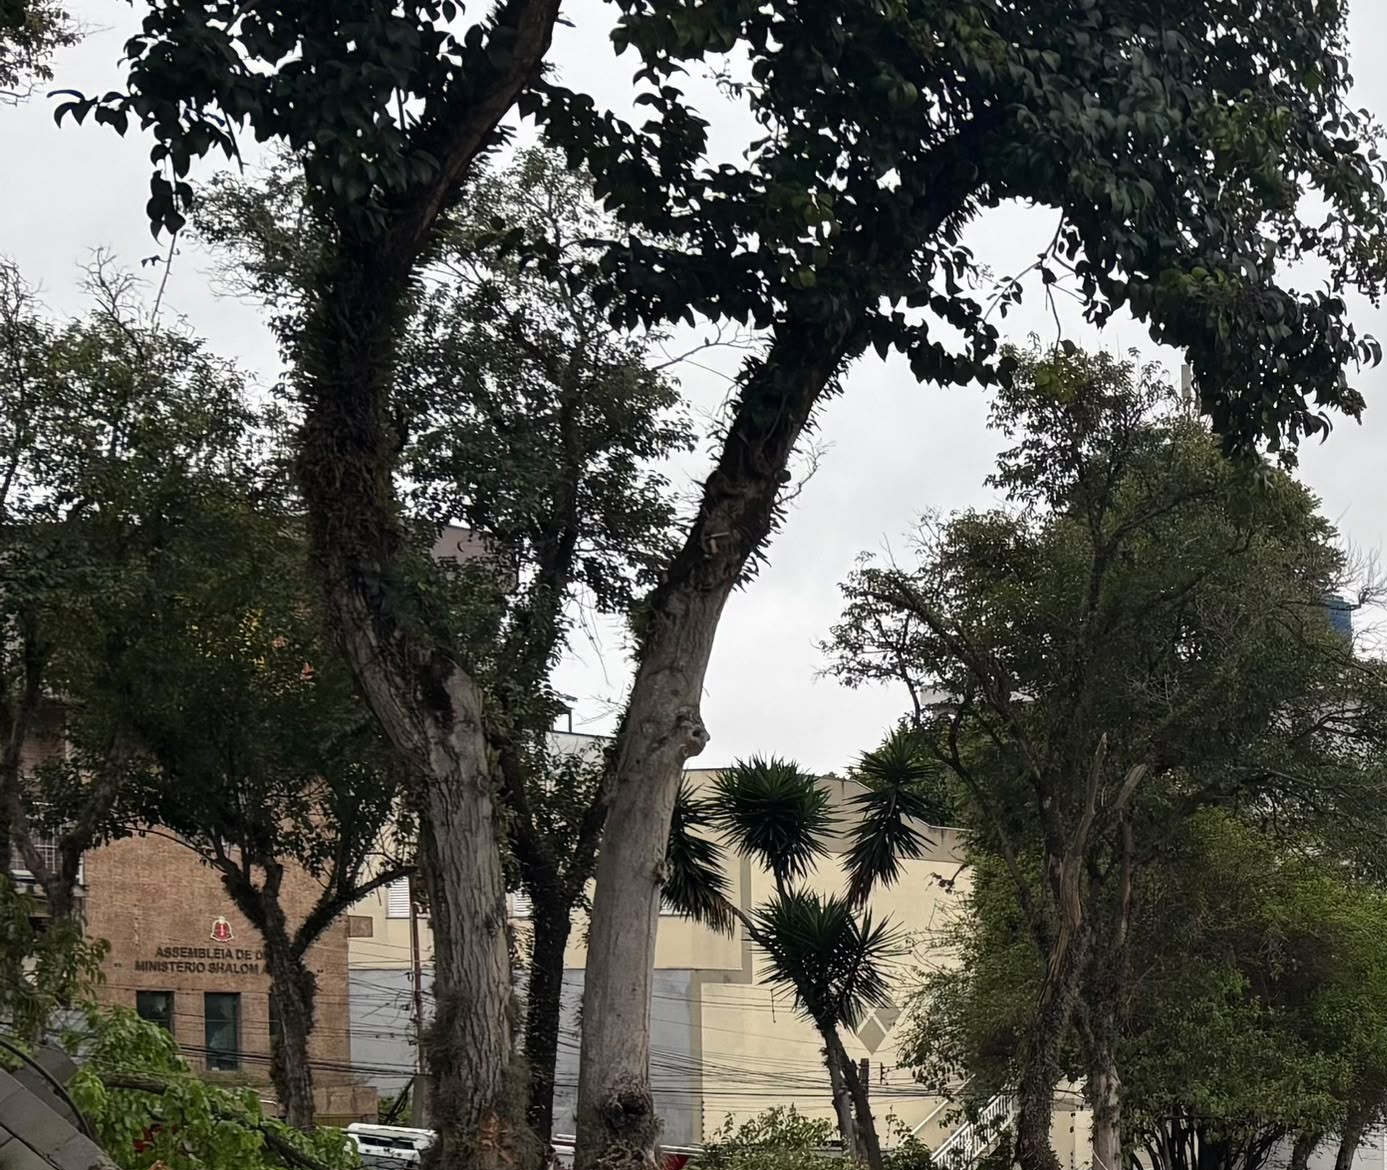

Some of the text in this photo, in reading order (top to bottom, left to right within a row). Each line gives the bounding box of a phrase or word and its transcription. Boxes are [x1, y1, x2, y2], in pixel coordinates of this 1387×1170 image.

[155, 947, 233, 960] ASSEMBLEIA
[236, 948, 252, 960] DE
[207, 962, 259, 974] SHALOM
